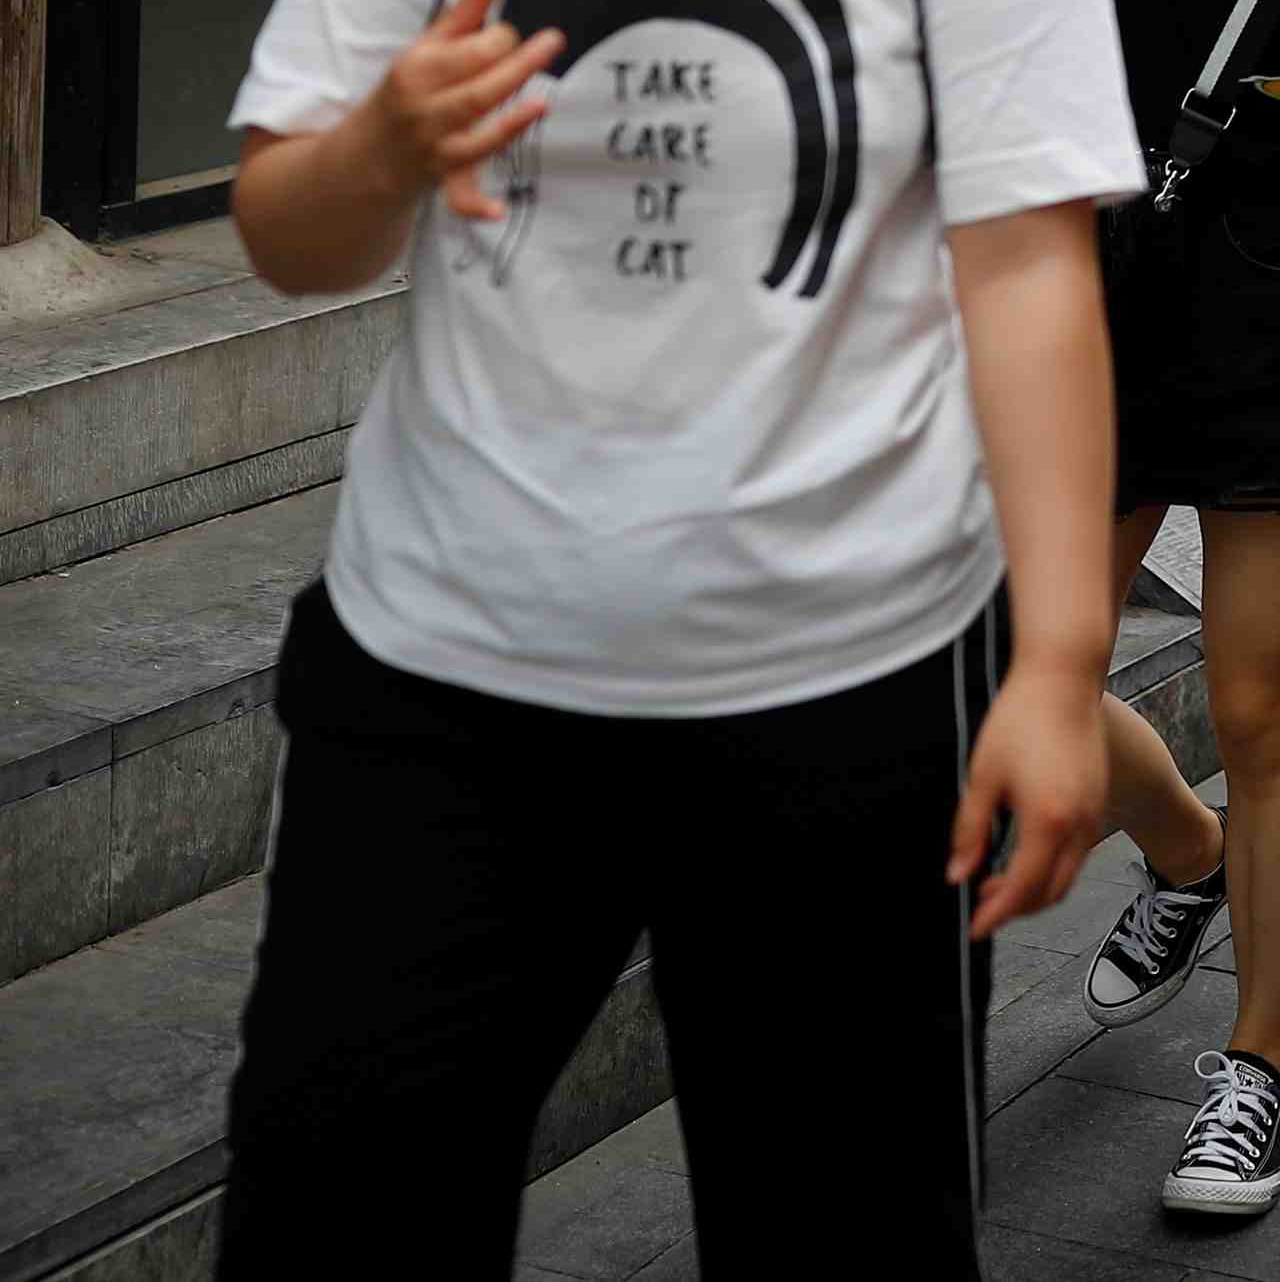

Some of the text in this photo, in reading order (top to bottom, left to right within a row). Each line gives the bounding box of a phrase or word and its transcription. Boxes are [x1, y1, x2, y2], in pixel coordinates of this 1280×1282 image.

[607, 61, 716, 102] TAKE
[605, 122, 713, 166] CARE
[634, 184, 684, 224] OF
[616, 237, 692, 281] CAT
